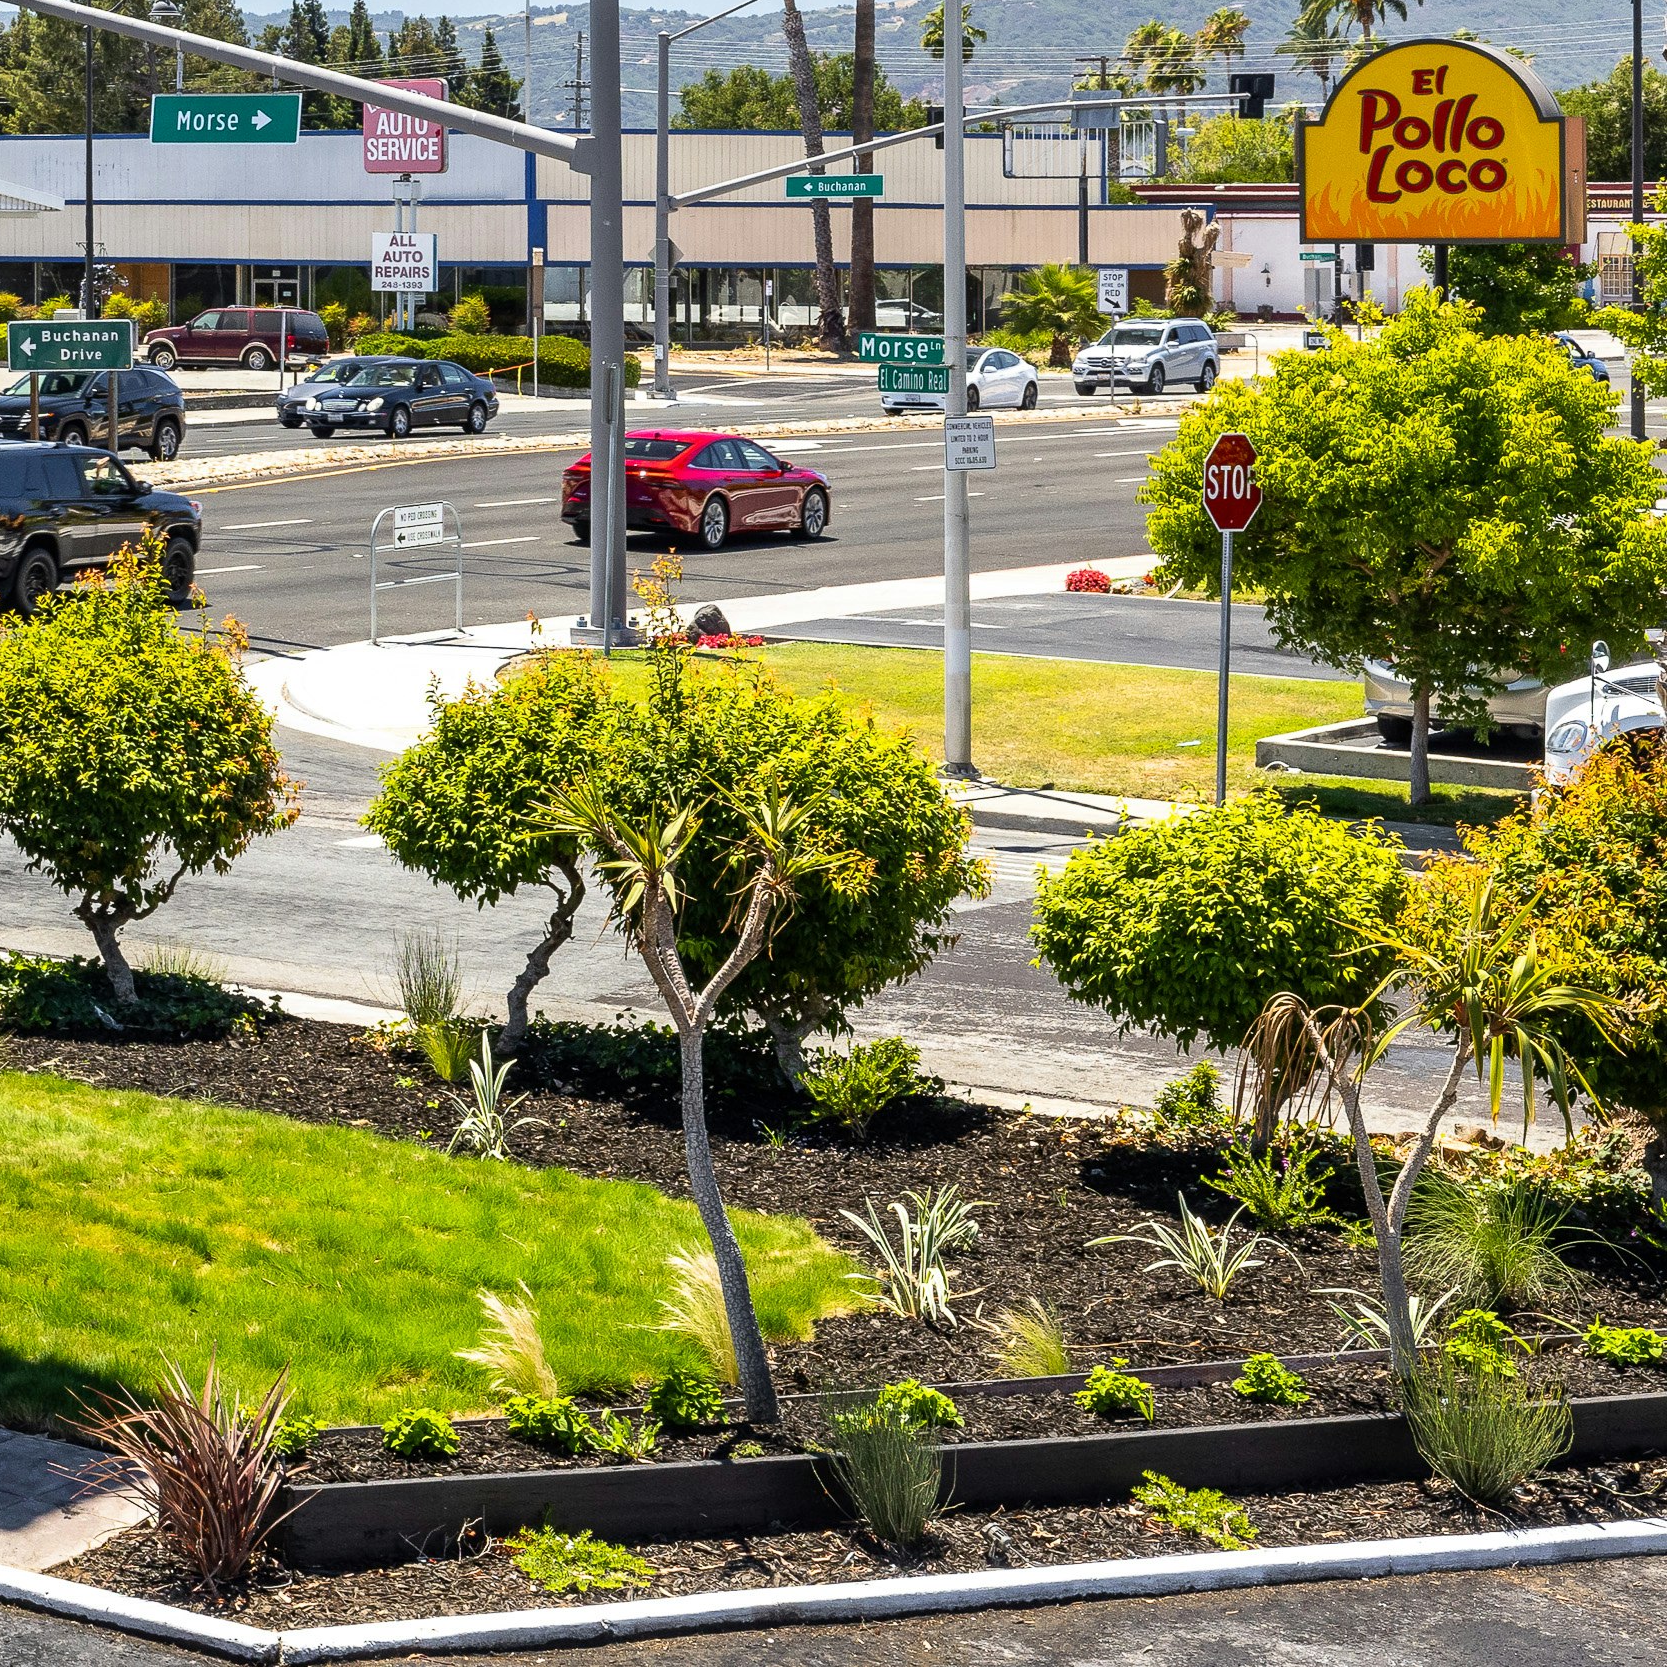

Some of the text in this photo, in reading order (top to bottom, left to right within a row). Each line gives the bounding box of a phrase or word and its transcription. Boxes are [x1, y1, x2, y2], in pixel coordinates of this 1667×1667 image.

[1411, 64, 1450, 96] El
[176, 110, 239, 131] Morse
[376, 112, 429, 136] AUTO
[1356, 88, 1506, 156] Pollo
[366, 137, 439, 161] SERVICE
[1366, 144, 1508, 205] Loco
[818, 181, 867, 192] Buchanan
[1586, 198, 1634, 209] ESTAURAN
[389, 234, 417, 247] ALL
[382, 250, 424, 263] AUTO
[375, 266, 430, 279] REPAIRS
[1103, 273, 1123, 281] STOP
[381, 281, 423, 289] 248-1393
[1104, 289, 1121, 297] RED
[41, 330, 119, 343] Buchanan
[60, 348, 102, 361] Drive
[861, 337, 942, 359] Morse Ln
[880, 368, 947, 391] El Camino Real
[946, 421, 992, 431] COMMERCIAL VEHICLES
[950, 434, 966, 443] LIMITED
[962, 446, 978, 454] PARKING
[1207, 464, 1258, 500] STOP
[400, 509, 438, 522] NO PED CROSSING
[417, 530, 441, 540] CROSSWALK
